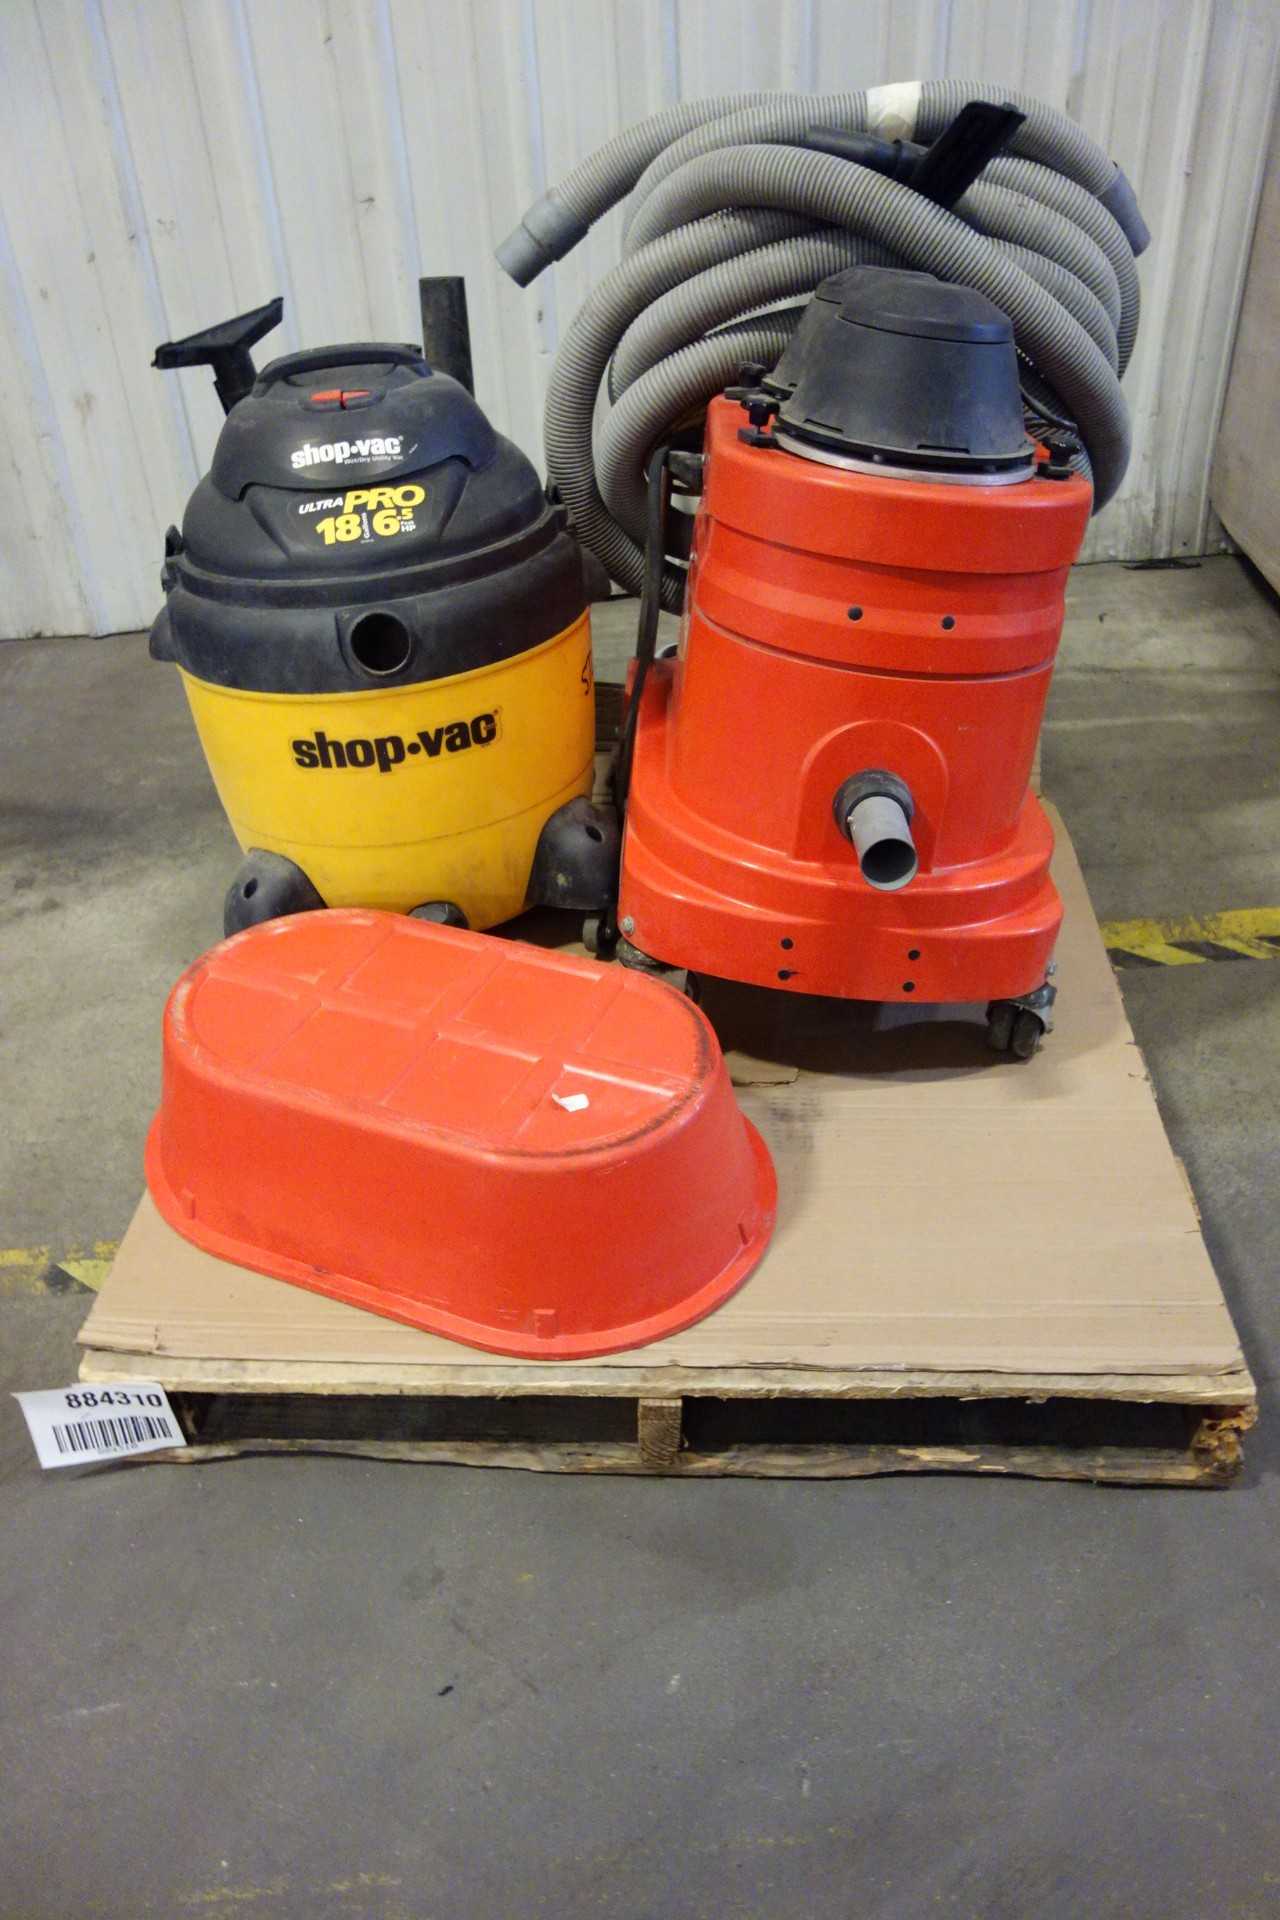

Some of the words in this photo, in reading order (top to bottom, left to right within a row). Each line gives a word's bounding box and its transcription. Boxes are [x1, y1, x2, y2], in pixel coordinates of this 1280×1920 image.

[299, 497, 343, 514] ULTRA
[343, 485, 426, 514] PRO
[315, 514, 362, 545] 18
[65, 1391, 163, 1409] 884310
